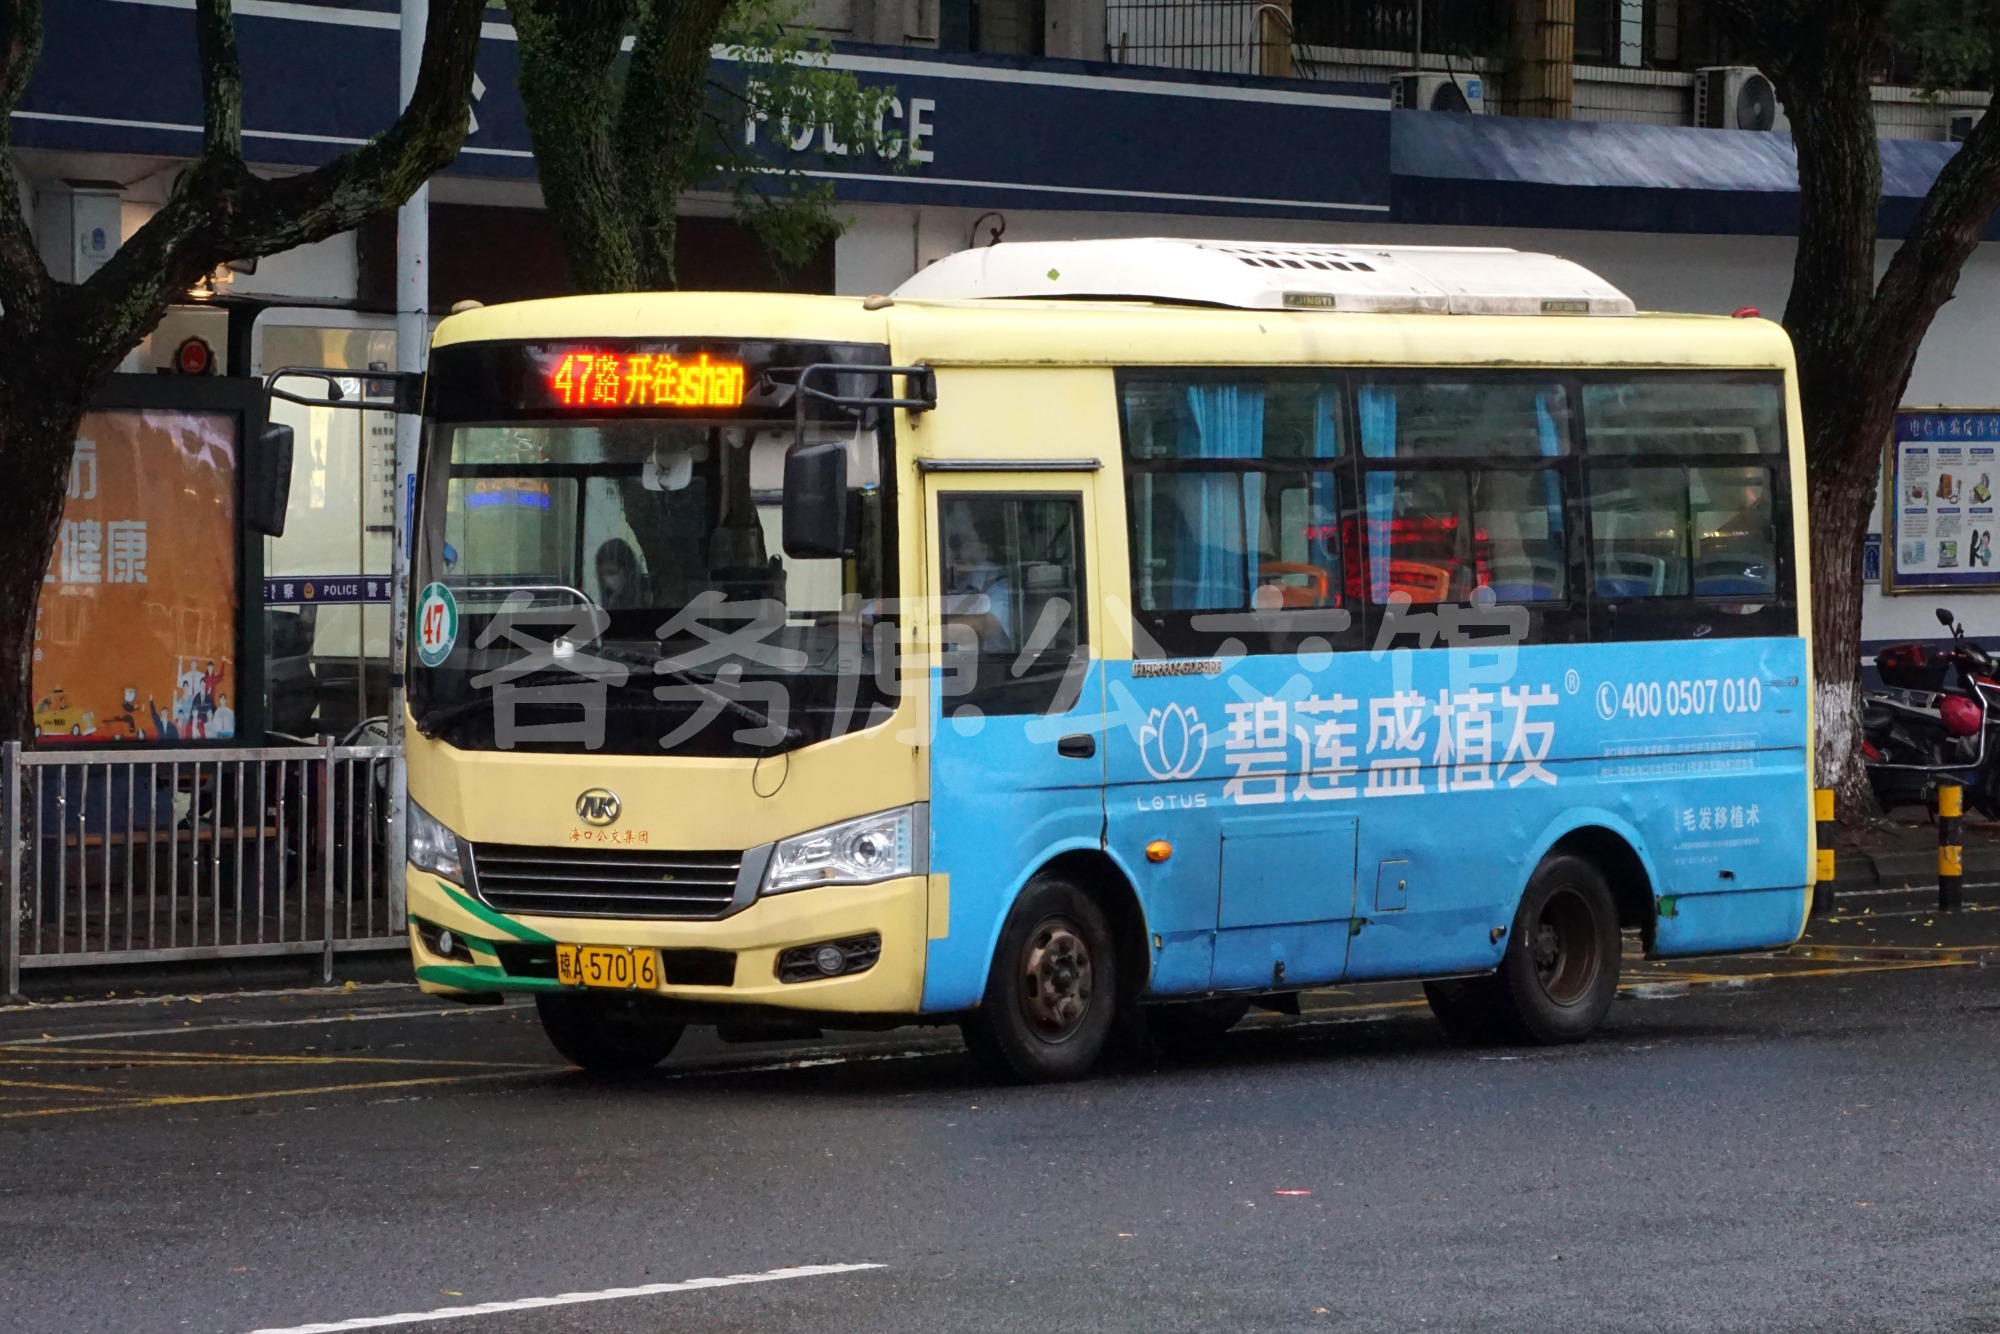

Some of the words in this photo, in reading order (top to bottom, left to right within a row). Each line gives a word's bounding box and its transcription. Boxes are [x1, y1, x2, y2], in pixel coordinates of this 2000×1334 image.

[744, 80, 936, 163] POLICE
[554, 354, 620, 404] 47路
[323, 584, 358, 596] POLICE
[423, 603, 445, 645] 47
[1621, 682, 1662, 718] 400
[1666, 679, 1718, 716] 0507
[1722, 677, 1761, 713] 010
[1222, 684, 1559, 806] 碧莲盛植发
[1137, 793, 1207, 811] LOTUS
[1683, 803, 1760, 832] 毛发移植术
[569, 828, 649, 844] 海口公交集团
